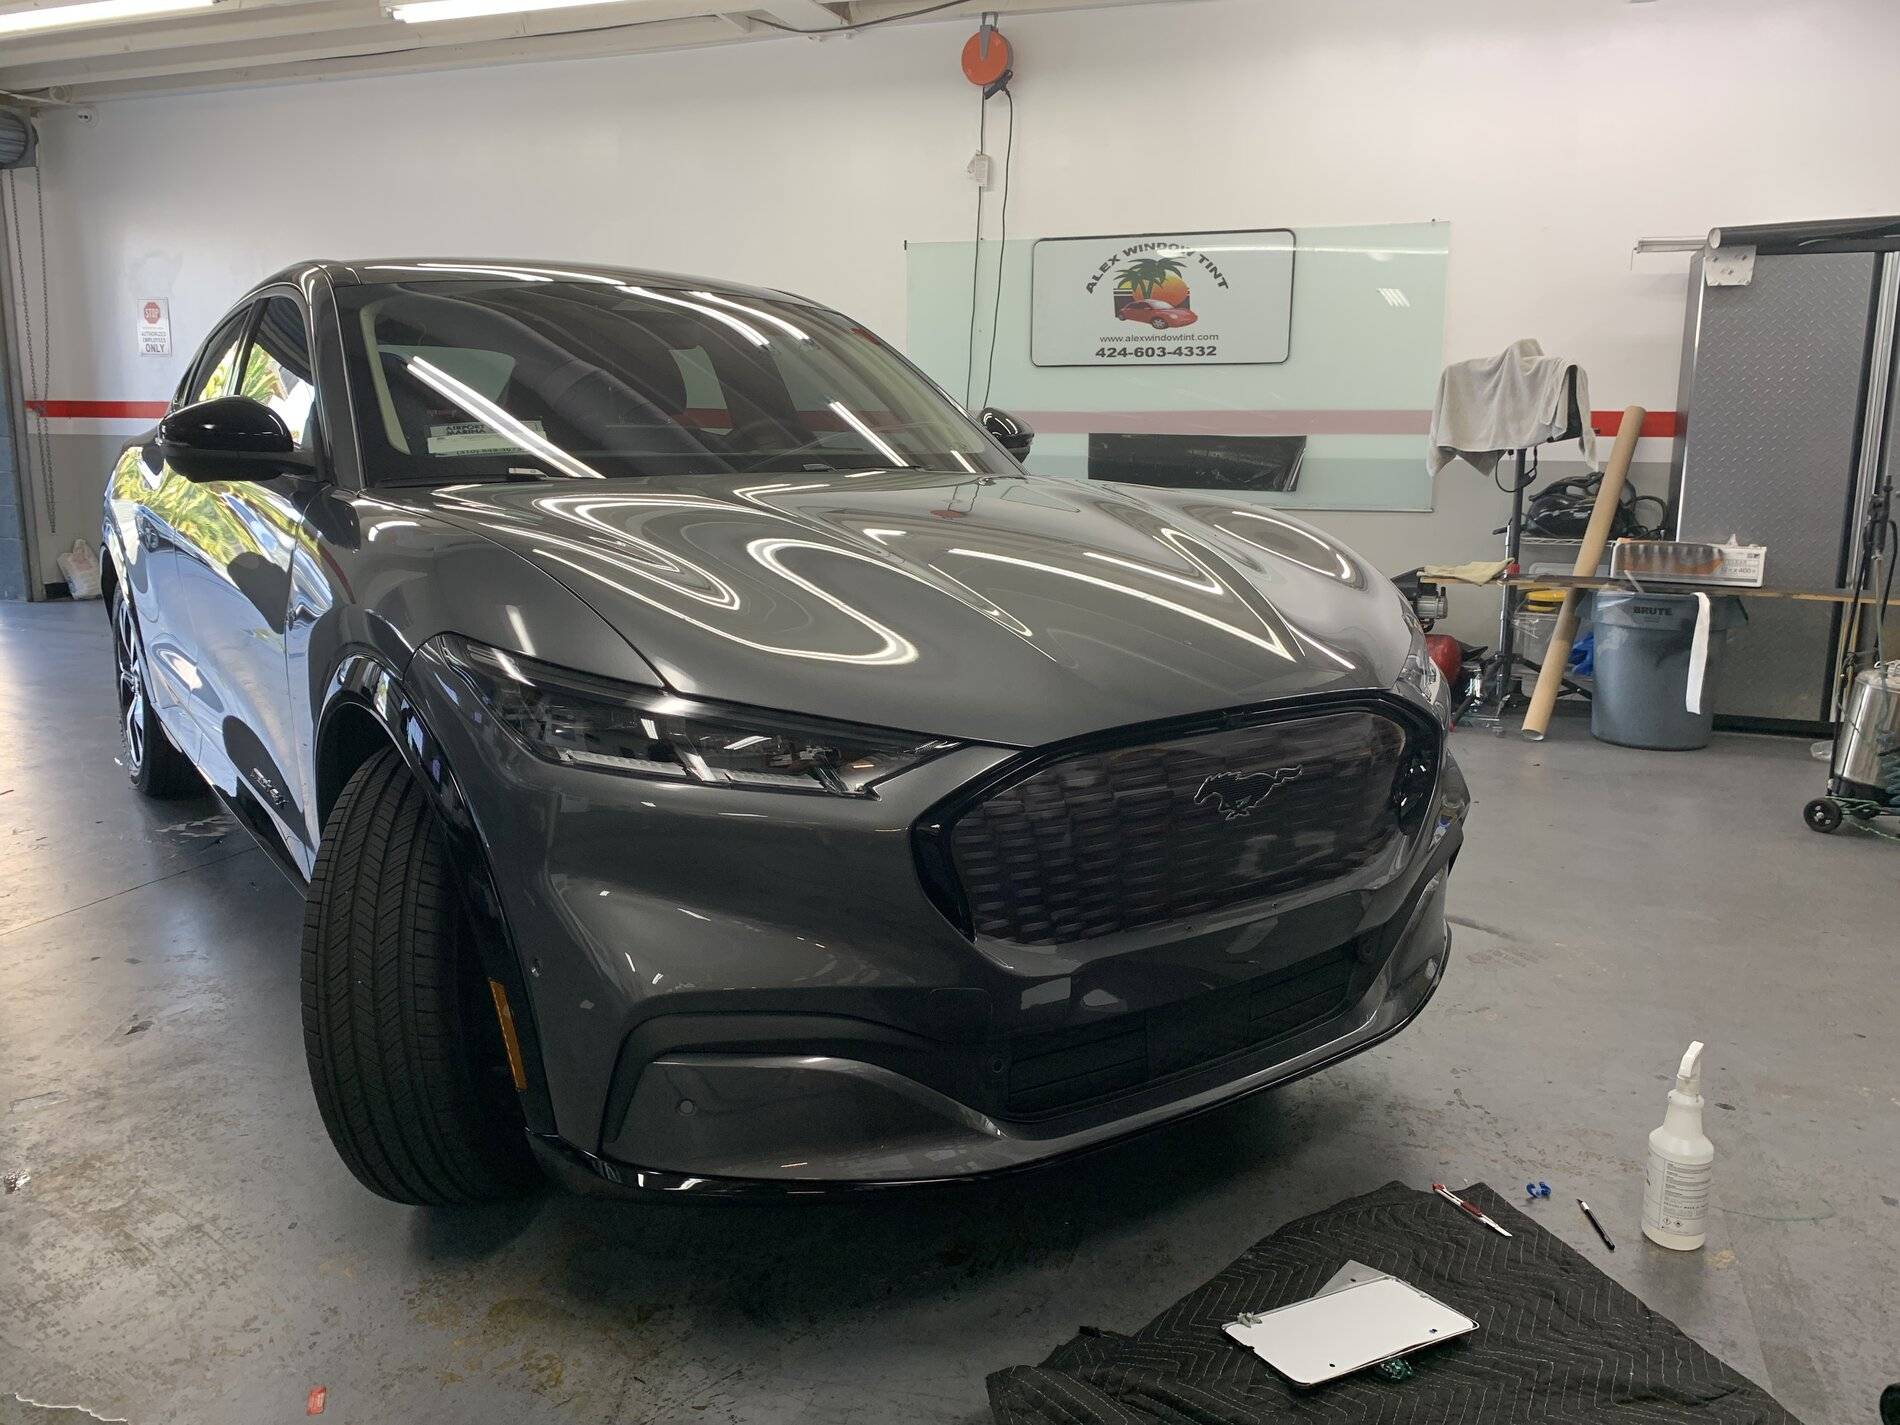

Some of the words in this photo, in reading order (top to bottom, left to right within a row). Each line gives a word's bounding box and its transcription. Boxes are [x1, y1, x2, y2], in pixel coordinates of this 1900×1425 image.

[1086, 254, 1121, 294] ALEX
[1198, 253, 1230, 291] TINT
[145, 308, 160, 319] STOP
[1099, 333, 1219, 343] www.alexwindowtint.com
[145, 343, 165, 353] ONLY
[1095, 345, 1217, 358] 424-603-4332
[1632, 606, 1673, 616] BRUTE
